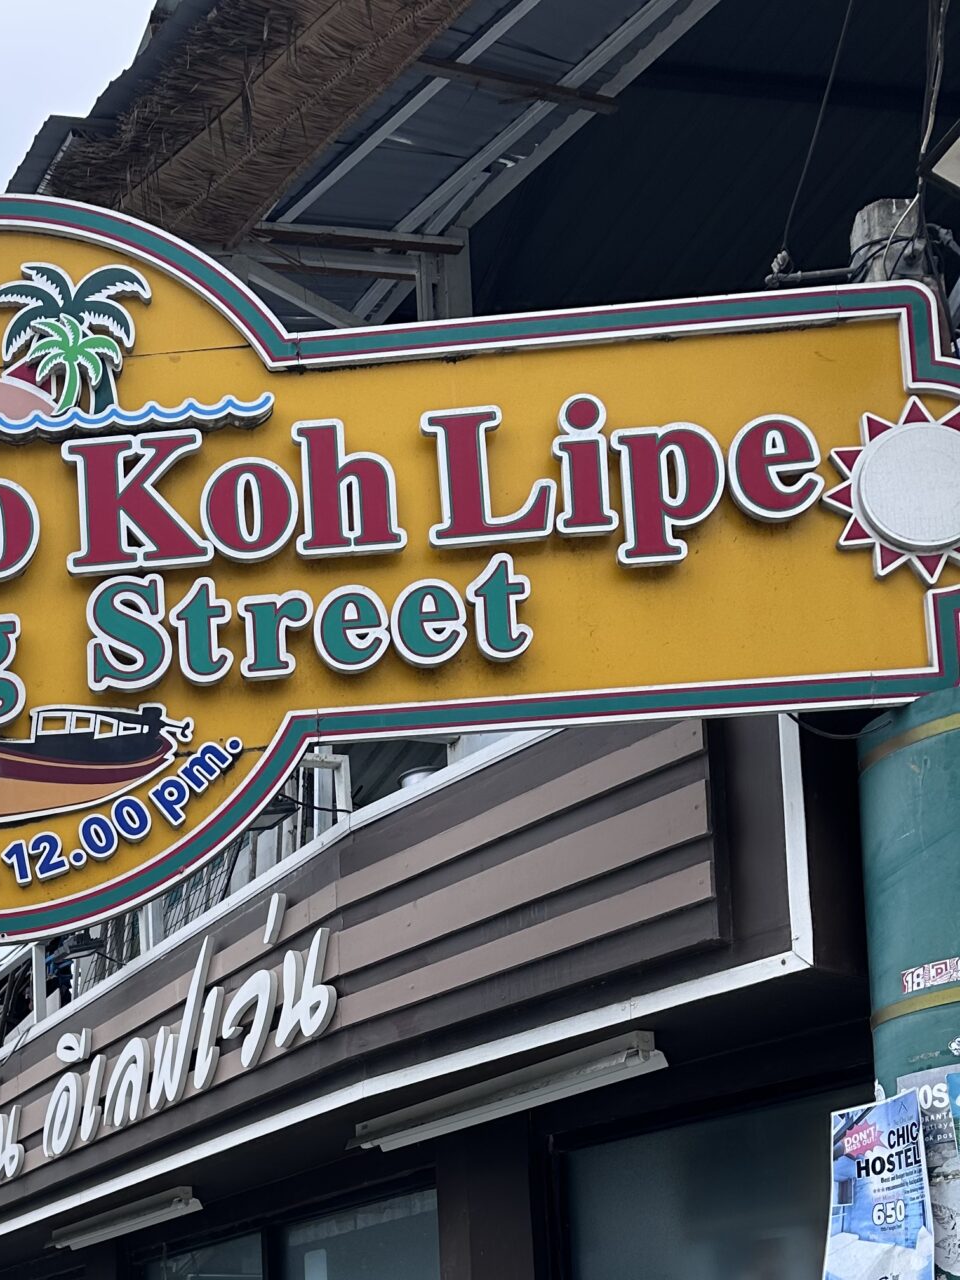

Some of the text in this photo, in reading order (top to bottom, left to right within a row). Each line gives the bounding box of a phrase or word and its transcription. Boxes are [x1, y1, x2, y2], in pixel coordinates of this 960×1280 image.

[61, 418, 407, 578] Koh
[420, 393, 826, 568] Lipe
[86, 552, 533, 694] Street
[1, 795, 153, 887] 12.00
[147, 736, 243, 827] pm.
[42, 892, 338, 1158] อีเลฟเว่น
[844, 1126, 875, 1147] DON'T
[856, 1144, 922, 1179] HOSTEL
[887, 1121, 919, 1149] CHIC
[872, 1199, 905, 1226] 650
